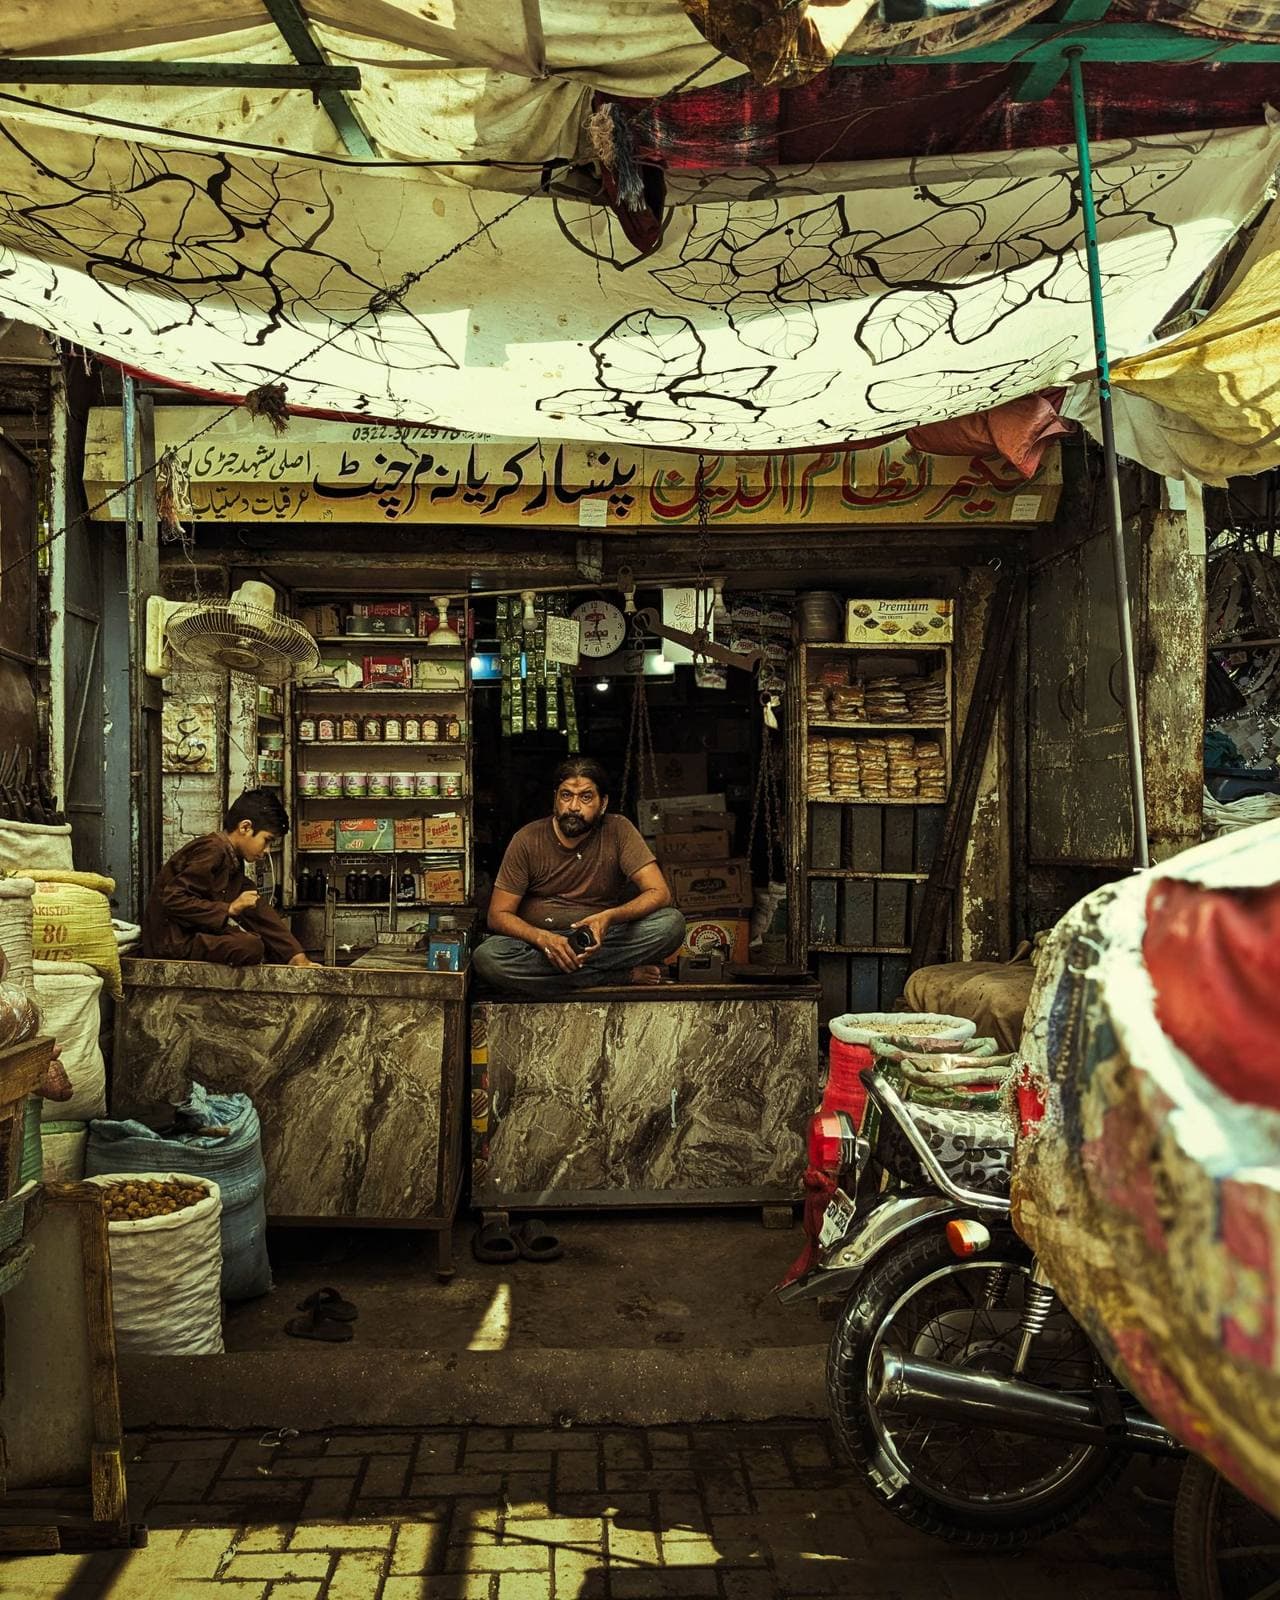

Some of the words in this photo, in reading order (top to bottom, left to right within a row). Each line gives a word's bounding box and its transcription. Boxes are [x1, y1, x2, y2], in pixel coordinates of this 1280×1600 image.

[194, 445, 241, 477] جڑی
[234, 444, 276, 478] شہد
[269, 448, 311, 480] اصلی
[313, 450, 435, 519] مرچنٹ
[521, 443, 638, 518] پنسار
[649, 456, 794, 524] الدین
[191, 486, 250, 520] دستیاب
[251, 486, 310, 520] عرقیات
[878, 601, 929, 612] Premium
[32, 905, 74, 916] AKISTAN
[43, 924, 68, 944] 80
